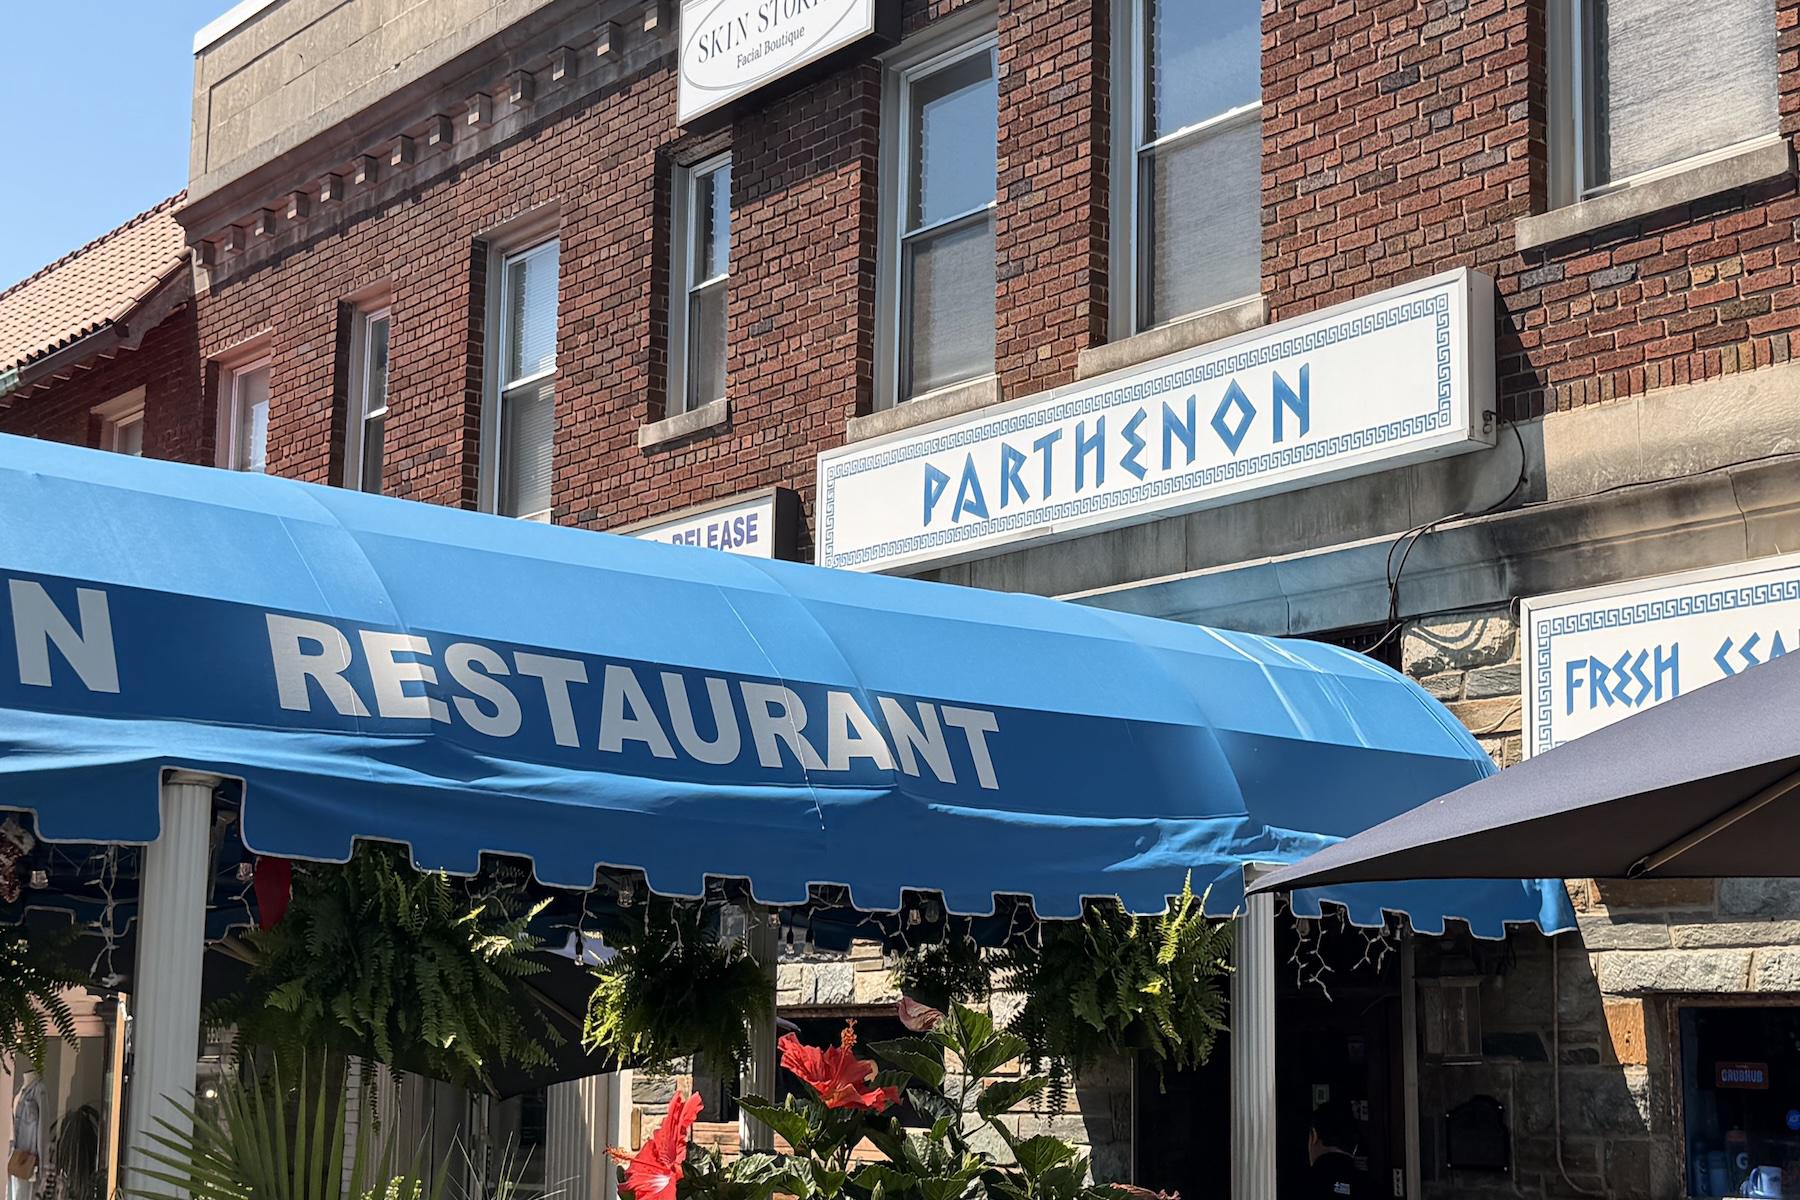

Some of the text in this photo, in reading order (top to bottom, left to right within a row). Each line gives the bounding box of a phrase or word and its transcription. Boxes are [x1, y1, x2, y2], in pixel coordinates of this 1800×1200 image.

[698, 12, 749, 64] SKIN
[736, 25, 805, 69] Facial Boutique
[923, 361, 1310, 528] PARTHENON
[265, 612, 1001, 791] RESTAURANT
[1566, 628, 1800, 716] FRESH SEA
